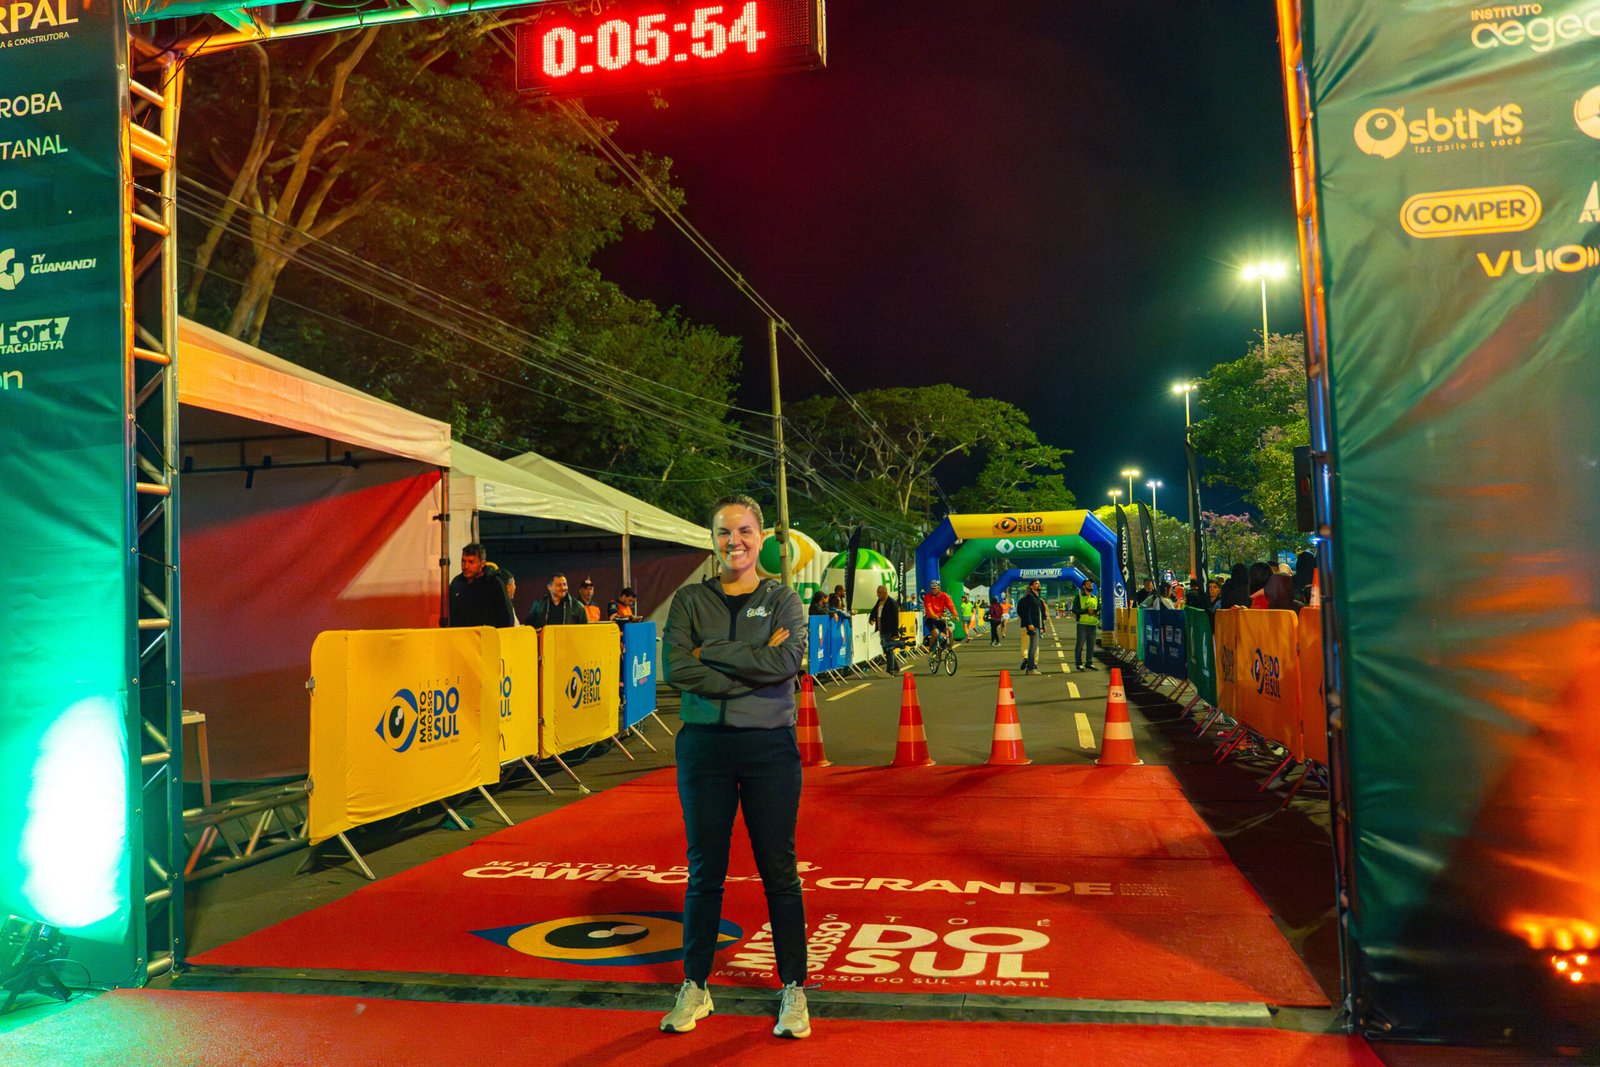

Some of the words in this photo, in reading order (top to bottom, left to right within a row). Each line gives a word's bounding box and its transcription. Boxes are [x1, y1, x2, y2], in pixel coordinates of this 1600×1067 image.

[1471, 4, 1543, 21] INSTITUTO
[7, 40, 14, 48] &
[15, 31, 70, 46] CONSTRUTORA
[542, 2, 766, 78] 0:05:54
[0, 91, 63, 118] ROBA
[1409, 103, 1523, 144] sbtMS
[0, 134, 68, 160] TANAL
[1413, 199, 1527, 225] COMPER
[30, 258, 97, 274] GUANANDI
[31, 254, 46, 264] TV
[4, 318, 62, 344] Fort
[0, 340, 64, 355] TACADISTA
[1026, 517, 1043, 525] DO
[1015, 539, 1060, 549] CORPAL
[500, 675, 512, 698] O
[590, 667, 601, 686] DO
[433, 687, 460, 716] DO
[590, 686, 601, 703] SUL
[433, 714, 460, 741] SUL
[484, 860, 656, 872] MARATONA
[462, 866, 690, 884] CAMPO
[815, 876, 1114, 896] GRANDE
[848, 923, 1050, 953] DO
[834, 949, 1050, 979] SUL
[811, 974, 865, 982] OSSO
[874, 976, 904, 984] DO
[913, 977, 950, 985] SUL
[975, 979, 1049, 988] BRASIL
